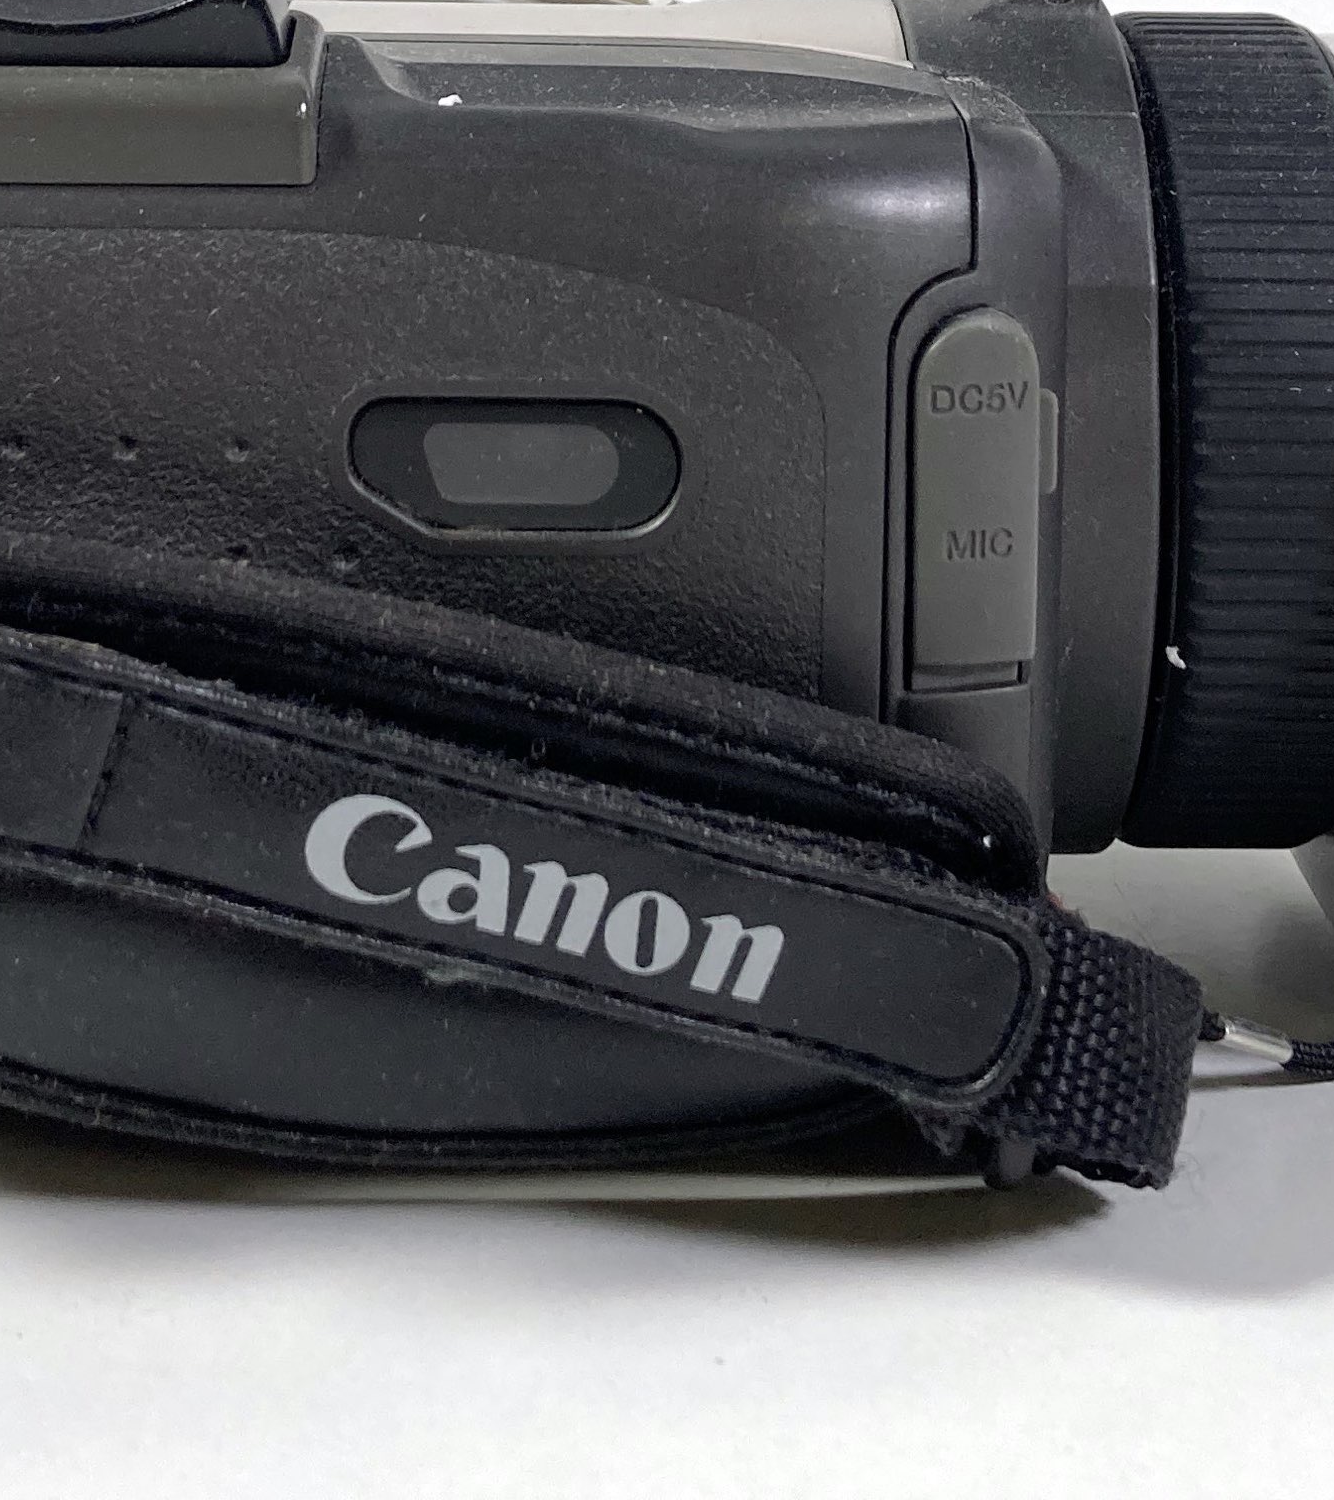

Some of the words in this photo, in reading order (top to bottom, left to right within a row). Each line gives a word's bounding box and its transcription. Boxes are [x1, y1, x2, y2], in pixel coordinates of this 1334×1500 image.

[929, 381, 1030, 414] DC5V
[946, 527, 1014, 561] MIC
[304, 793, 786, 1003] Canon
